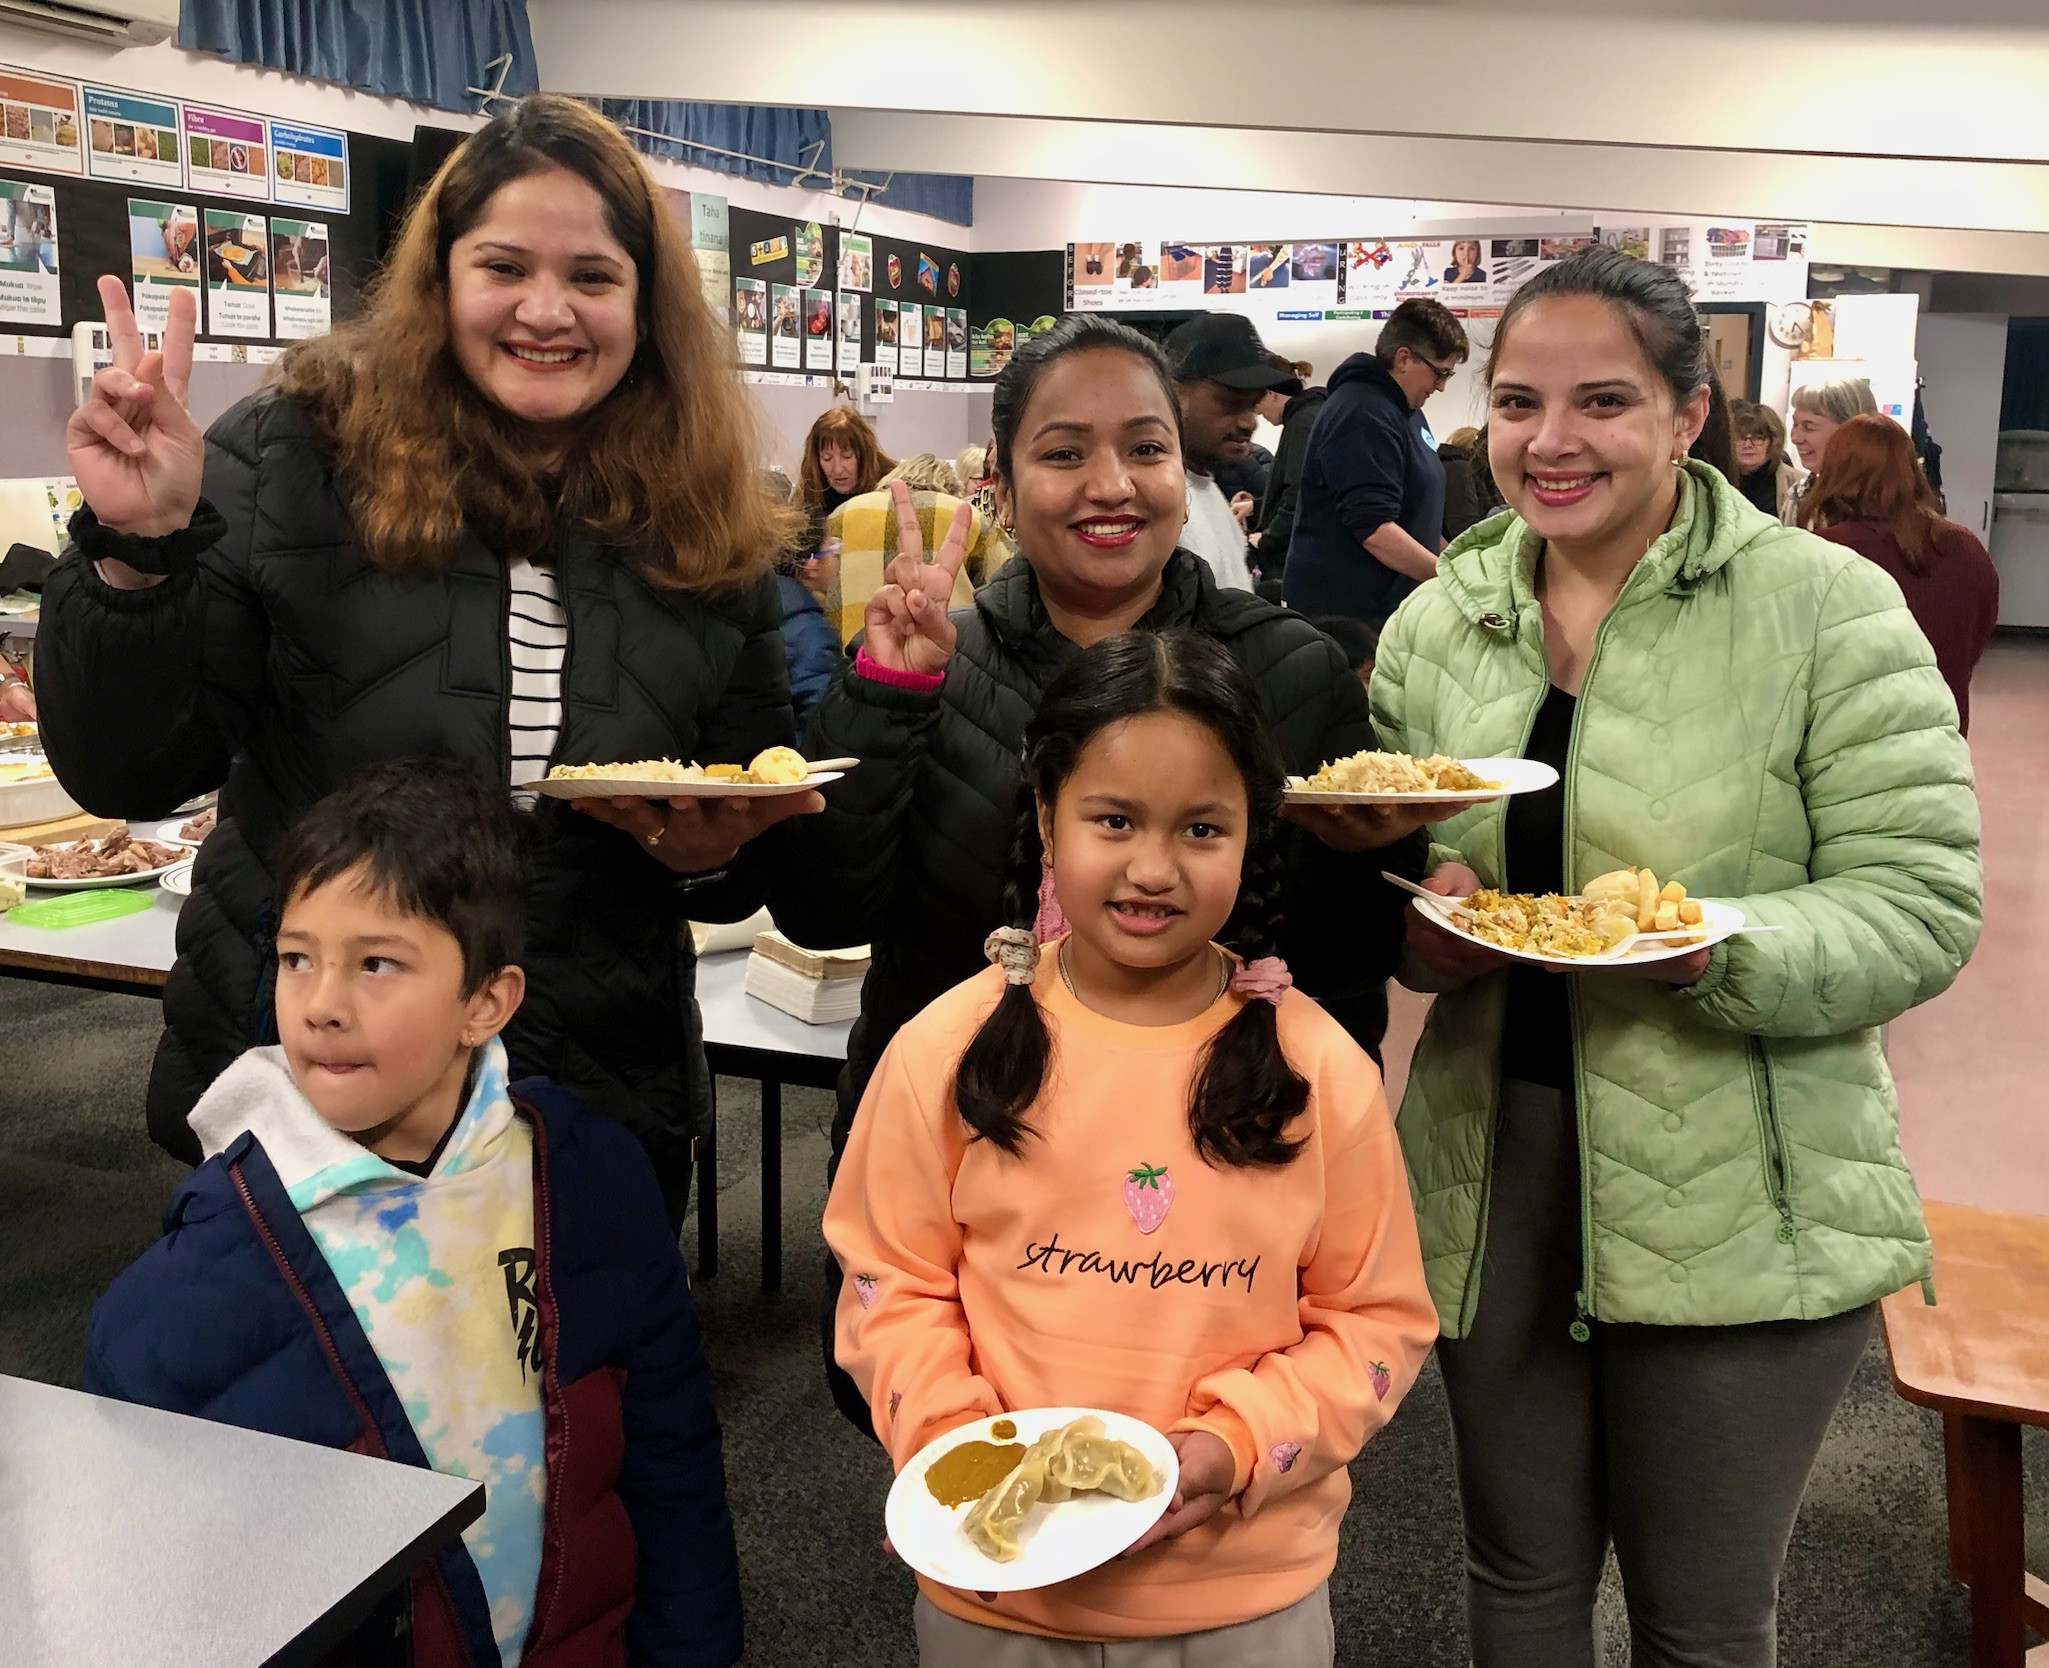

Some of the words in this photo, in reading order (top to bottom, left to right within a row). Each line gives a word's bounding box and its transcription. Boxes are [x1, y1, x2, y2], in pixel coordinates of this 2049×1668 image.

[88, 95, 119, 109] Proteins
[187, 113, 205, 124] Fibre
[274, 128, 315, 144] Carbohydrates
[701, 204, 720, 219] Taha
[699, 230, 724, 245] tinana
[1067, 243, 1075, 309] BEFORE
[22, 295, 30, 303] te
[1074, 288, 1113, 297] Closed-toe
[1082, 298, 1104, 307] Shoes
[1279, 312, 1307, 320] Managing
[1016, 1232, 1262, 1294] strawberry
